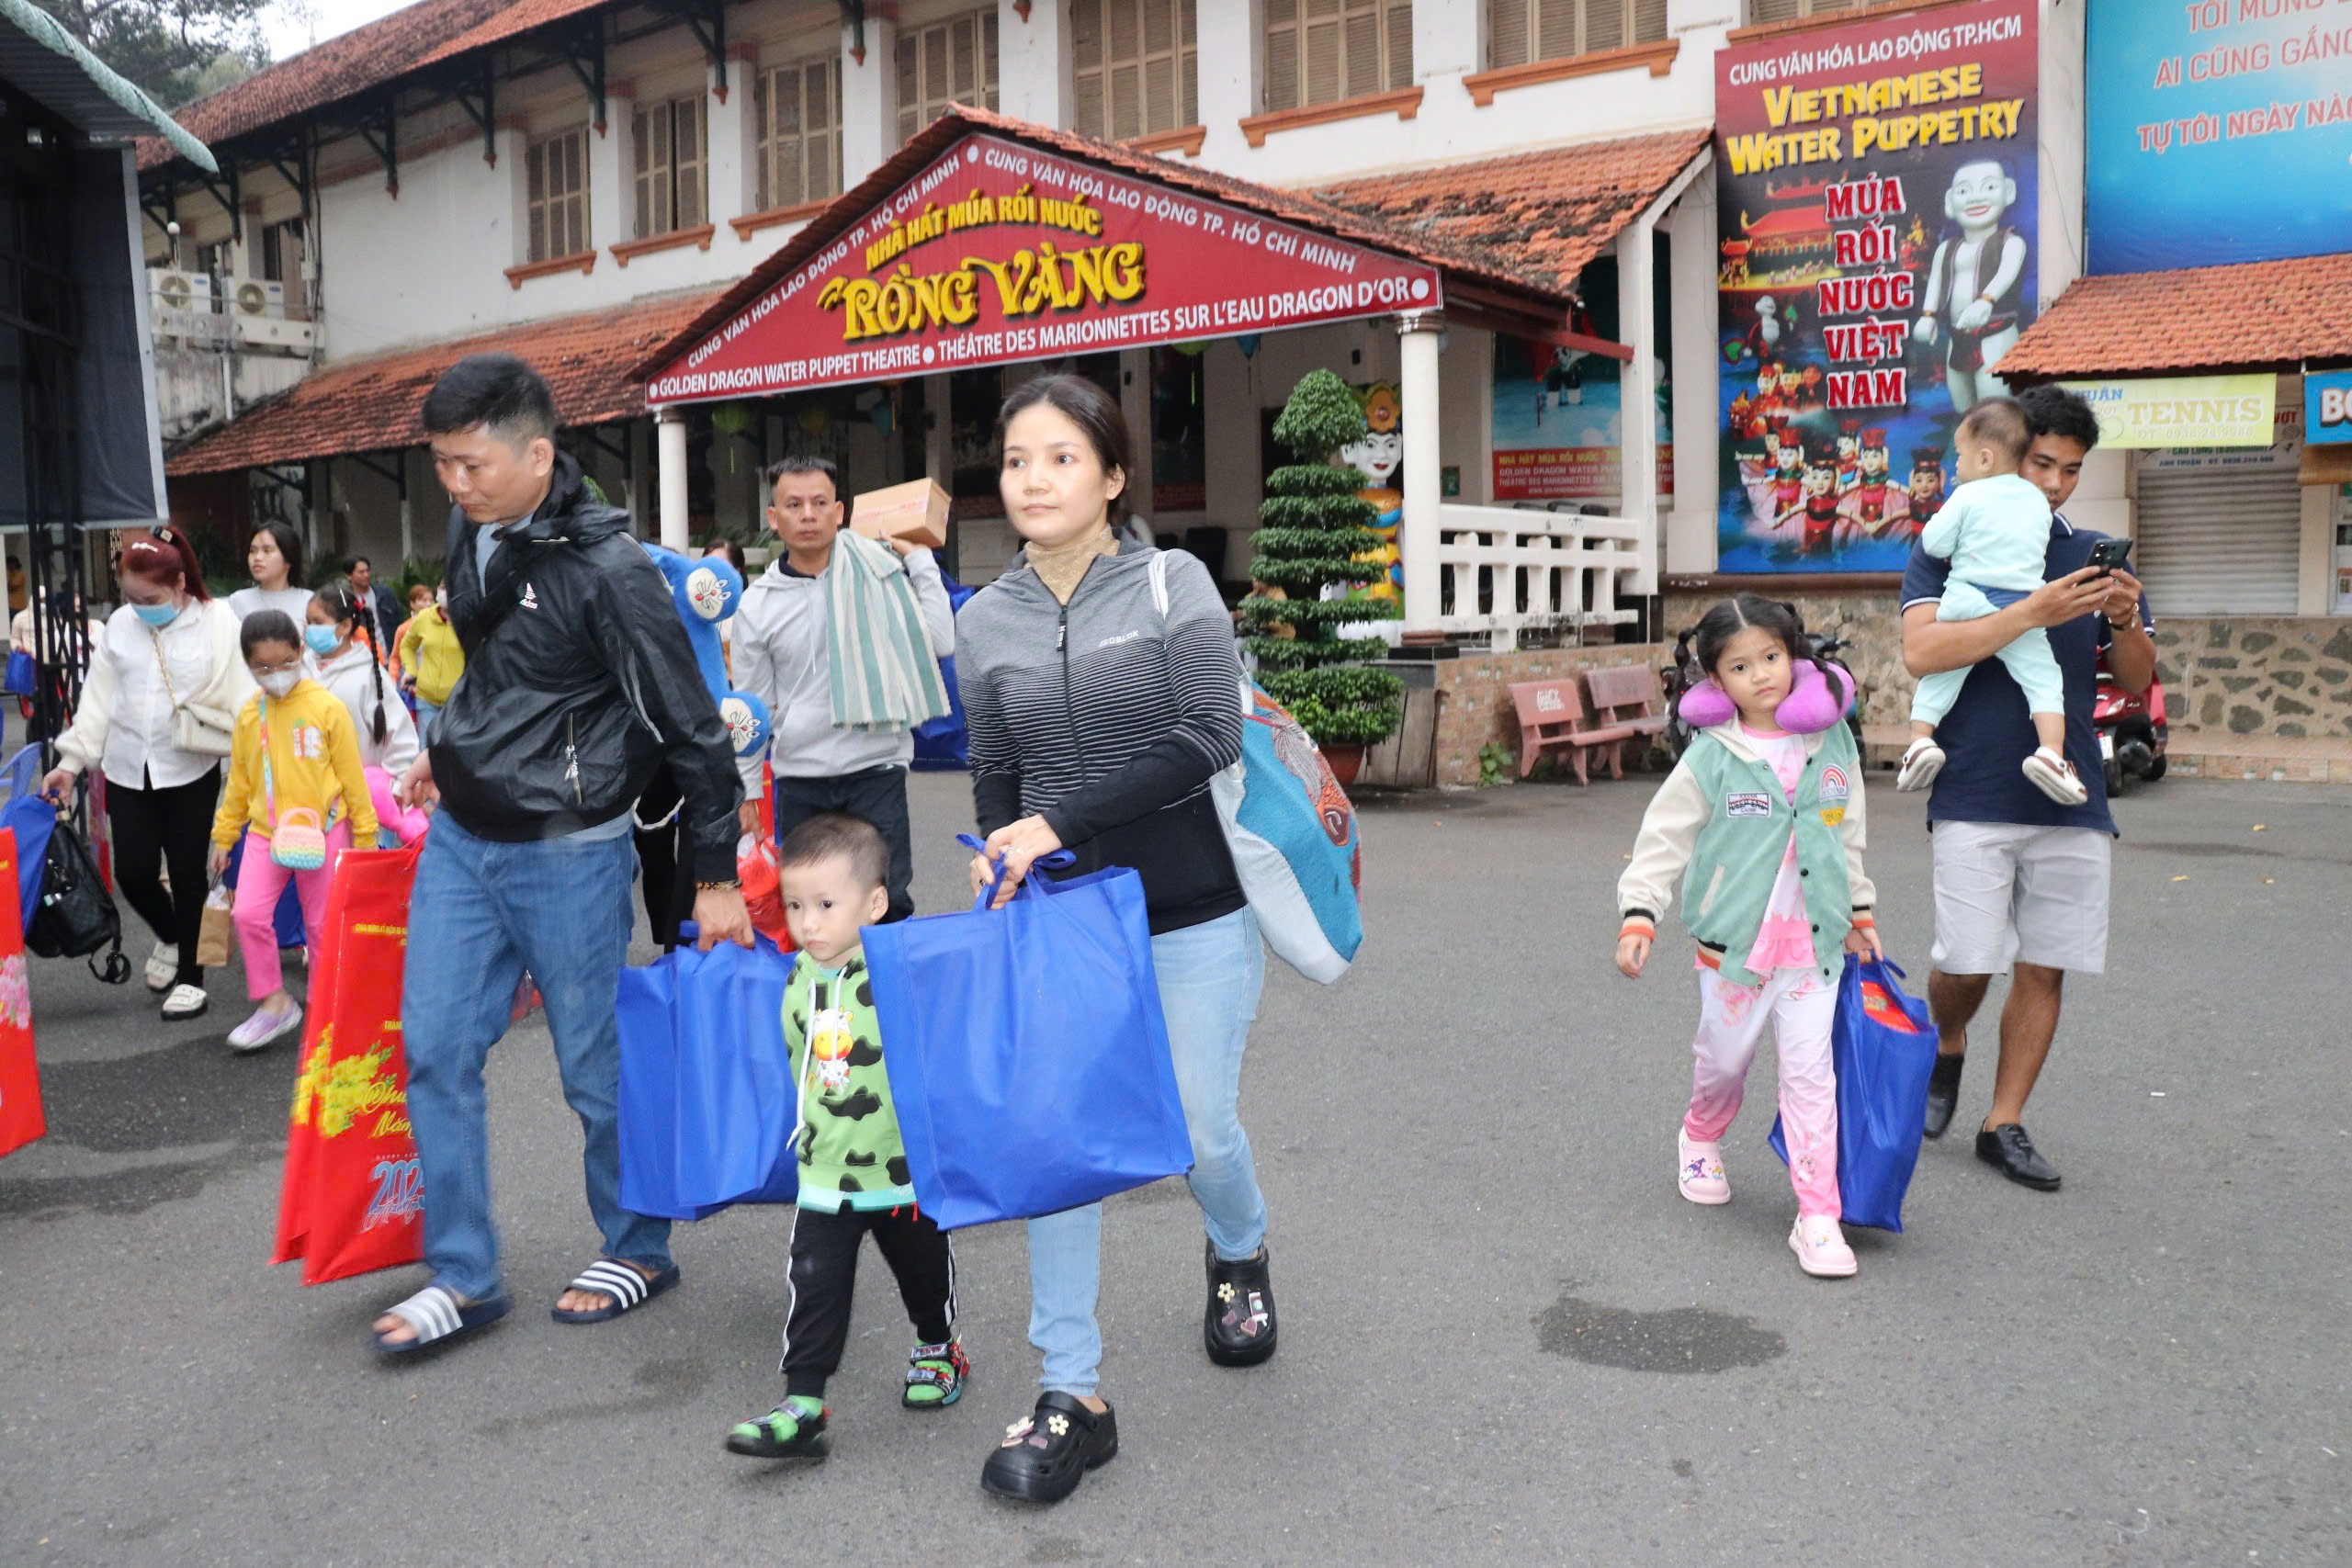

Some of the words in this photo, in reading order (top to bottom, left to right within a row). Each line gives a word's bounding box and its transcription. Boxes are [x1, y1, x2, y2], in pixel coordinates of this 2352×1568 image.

[1729, 59, 1777, 85] CUNG
[1779, 51, 1814, 77] VĂN
[1816, 43, 1854, 72] HÓA
[1857, 38, 1893, 65] LAO
[1895, 28, 1951, 61] ĐỘNG
[1952, 15, 2021, 47] TP.HCM
[2154, 57, 2181, 88] AI
[2188, 43, 2270, 82] CŨNG
[2138, 120, 2174, 155] TỰ
[2177, 113, 2219, 146] TÔI
[2227, 101, 2300, 139] NGÀY
[985, 149, 1028, 176] CUNG
[1108, 184, 1141, 209] LAO
[1144, 196, 1198, 226] ĐỘNG
[1265, 231, 1300, 257] CHÍ
[1300, 242, 1357, 275] MINH
[1825, 172, 1905, 221] MÚA
[865, 220, 908, 273] NHÀ
[907, 202, 947, 247] HÁT
[947, 188, 996, 229] MÚA
[998, 184, 1038, 222] RỐI
[1040, 193, 1102, 236] NƯỚC
[1834, 218, 1896, 267] RỐI
[688, 334, 722, 368] CUNG
[781, 272, 806, 301] LAO
[808, 241, 848, 280] ĐỘNG
[896, 182, 919, 213] CHÍ
[921, 153, 959, 196] MINH
[816, 263, 978, 340] RỒNG
[961, 242, 1146, 316] VÀNG
[1817, 266, 1913, 316] NƯỚC
[659, 376, 707, 397] GOLDEN
[708, 365, 763, 390] DRAGON
[763, 359, 806, 384] WATER
[808, 354, 859, 378] PUPPET
[859, 344, 920, 372] THEATRE
[938, 331, 1003, 362] THÉÂTRE
[1006, 327, 1035, 353] DES
[1039, 307, 1170, 348] MARIONNETTES
[1174, 304, 1211, 332] SUR
[1269, 283, 1352, 320] DRAGON
[1823, 317, 1909, 366] VIỆT
[1826, 369, 1906, 409] NAM
[2127, 396, 2264, 425] TENNIS
